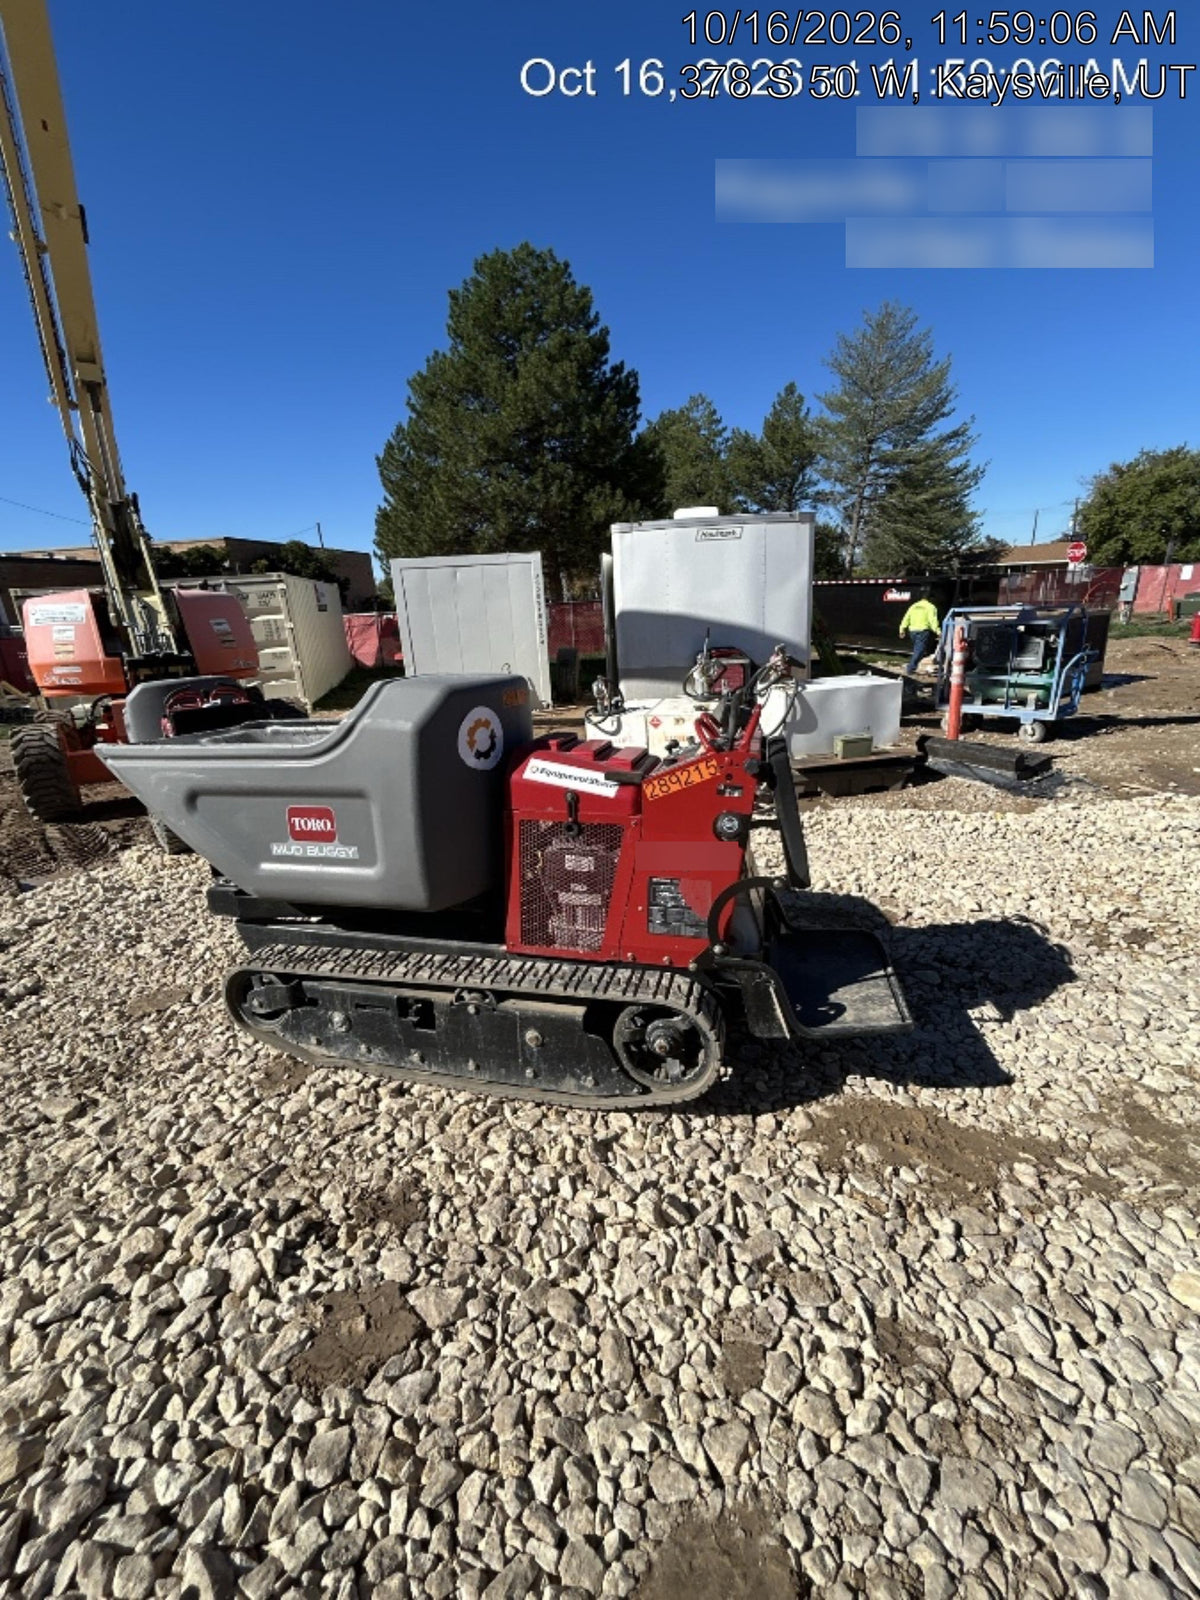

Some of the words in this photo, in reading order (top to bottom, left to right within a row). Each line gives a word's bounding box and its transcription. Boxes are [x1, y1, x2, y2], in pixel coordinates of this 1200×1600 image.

[645, 759, 717, 799] 289215
[290, 817, 331, 832] TORO
[271, 843, 303, 856] MUD
[306, 845, 355, 859] BUGGY
